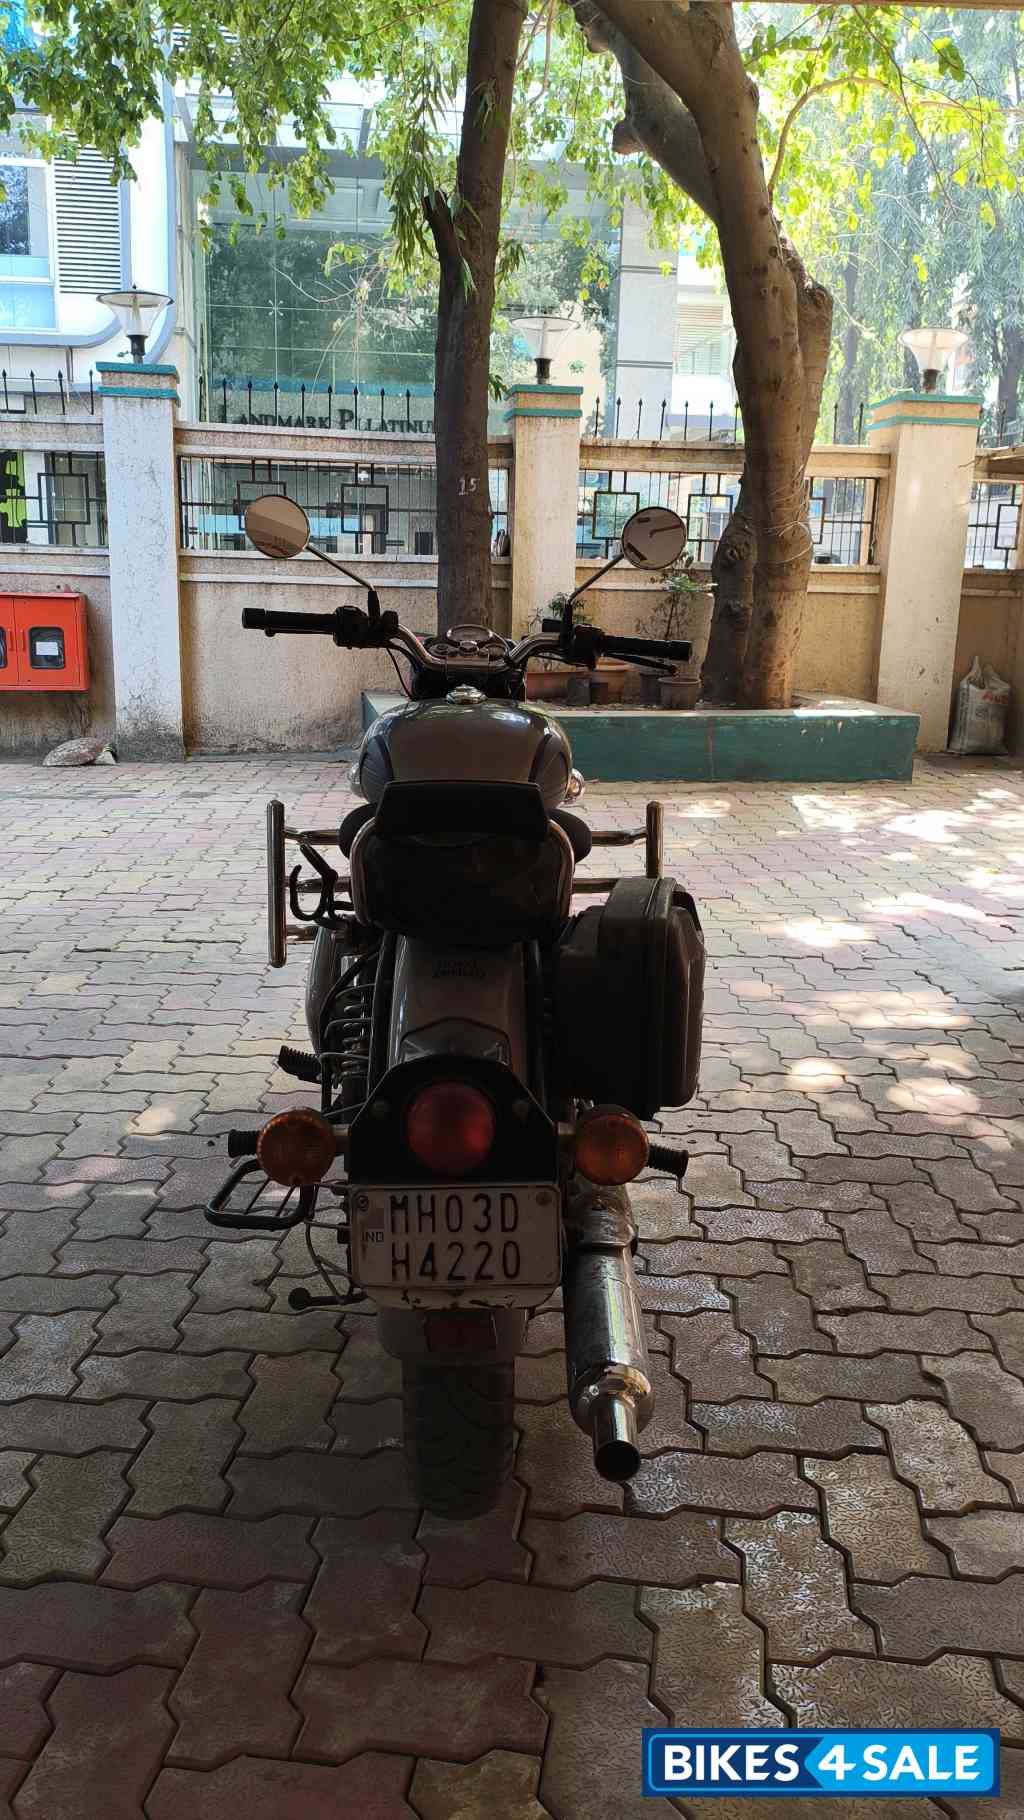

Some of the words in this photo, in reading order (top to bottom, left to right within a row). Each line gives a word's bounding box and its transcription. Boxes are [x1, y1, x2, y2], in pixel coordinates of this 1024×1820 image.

[336, 408, 433, 433] PLATINU
[389, 1193, 519, 1235] MH03D
[391, 1240, 521, 1282] H4220
